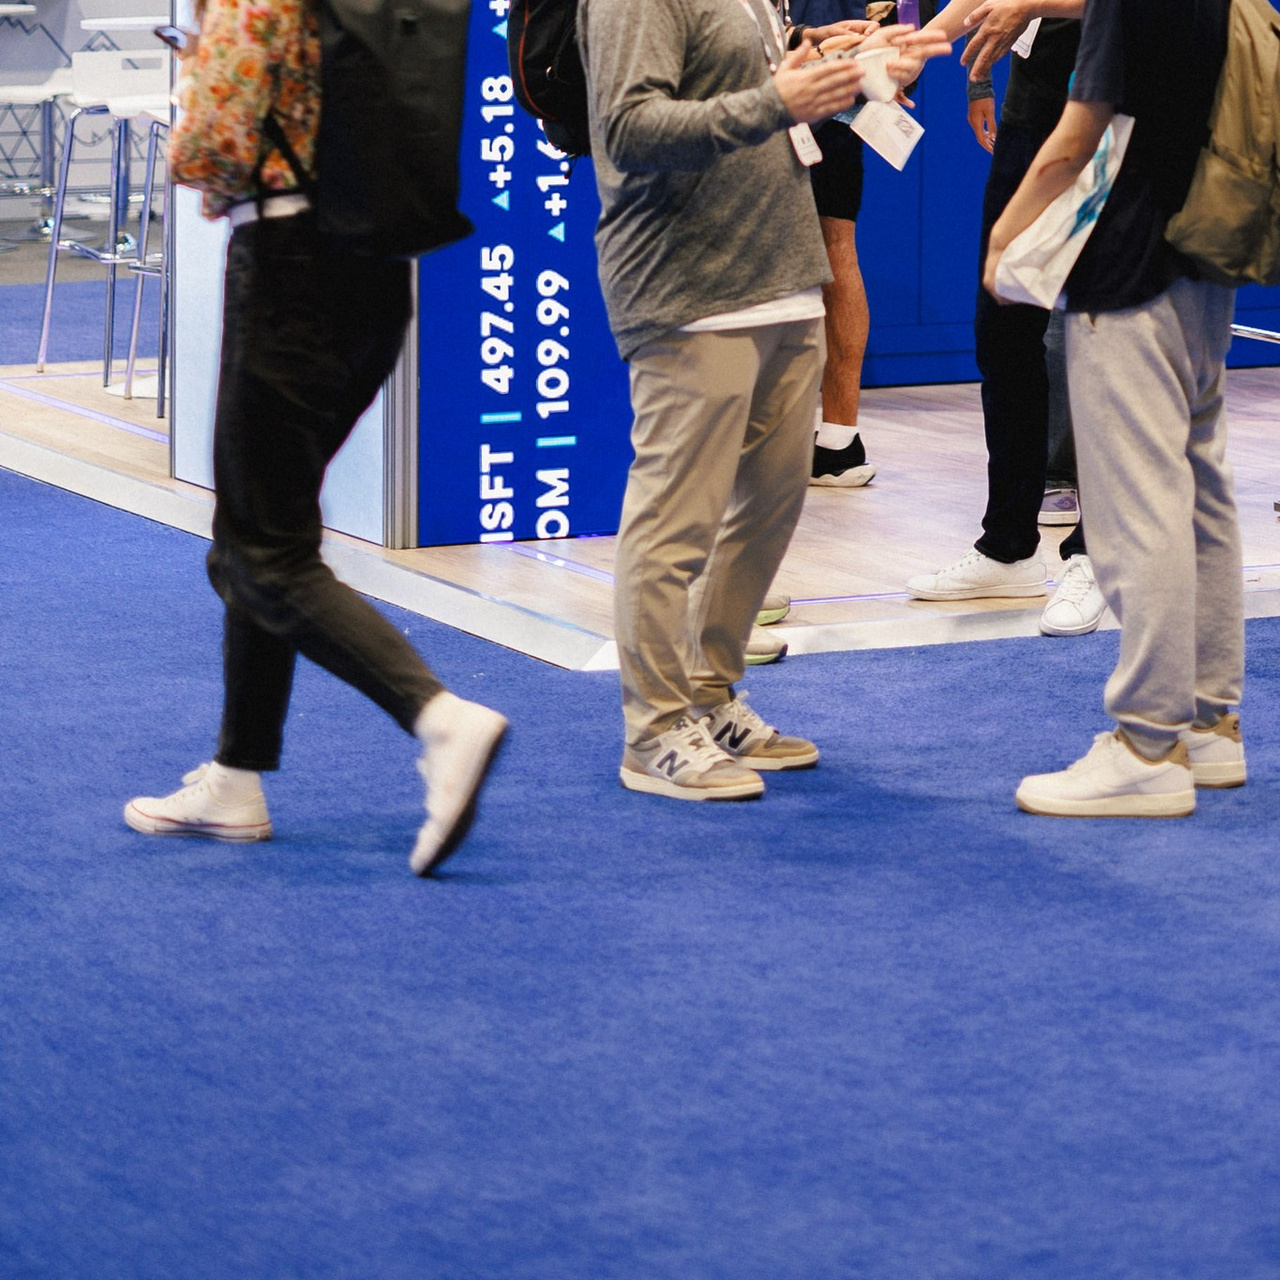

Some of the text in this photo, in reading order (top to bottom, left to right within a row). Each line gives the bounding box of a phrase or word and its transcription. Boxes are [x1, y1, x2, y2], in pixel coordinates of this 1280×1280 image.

[482, 77, 513, 187] +5.18
[481, 245, 514, 394] 497.45
[536, 270, 569, 418] 109.99
